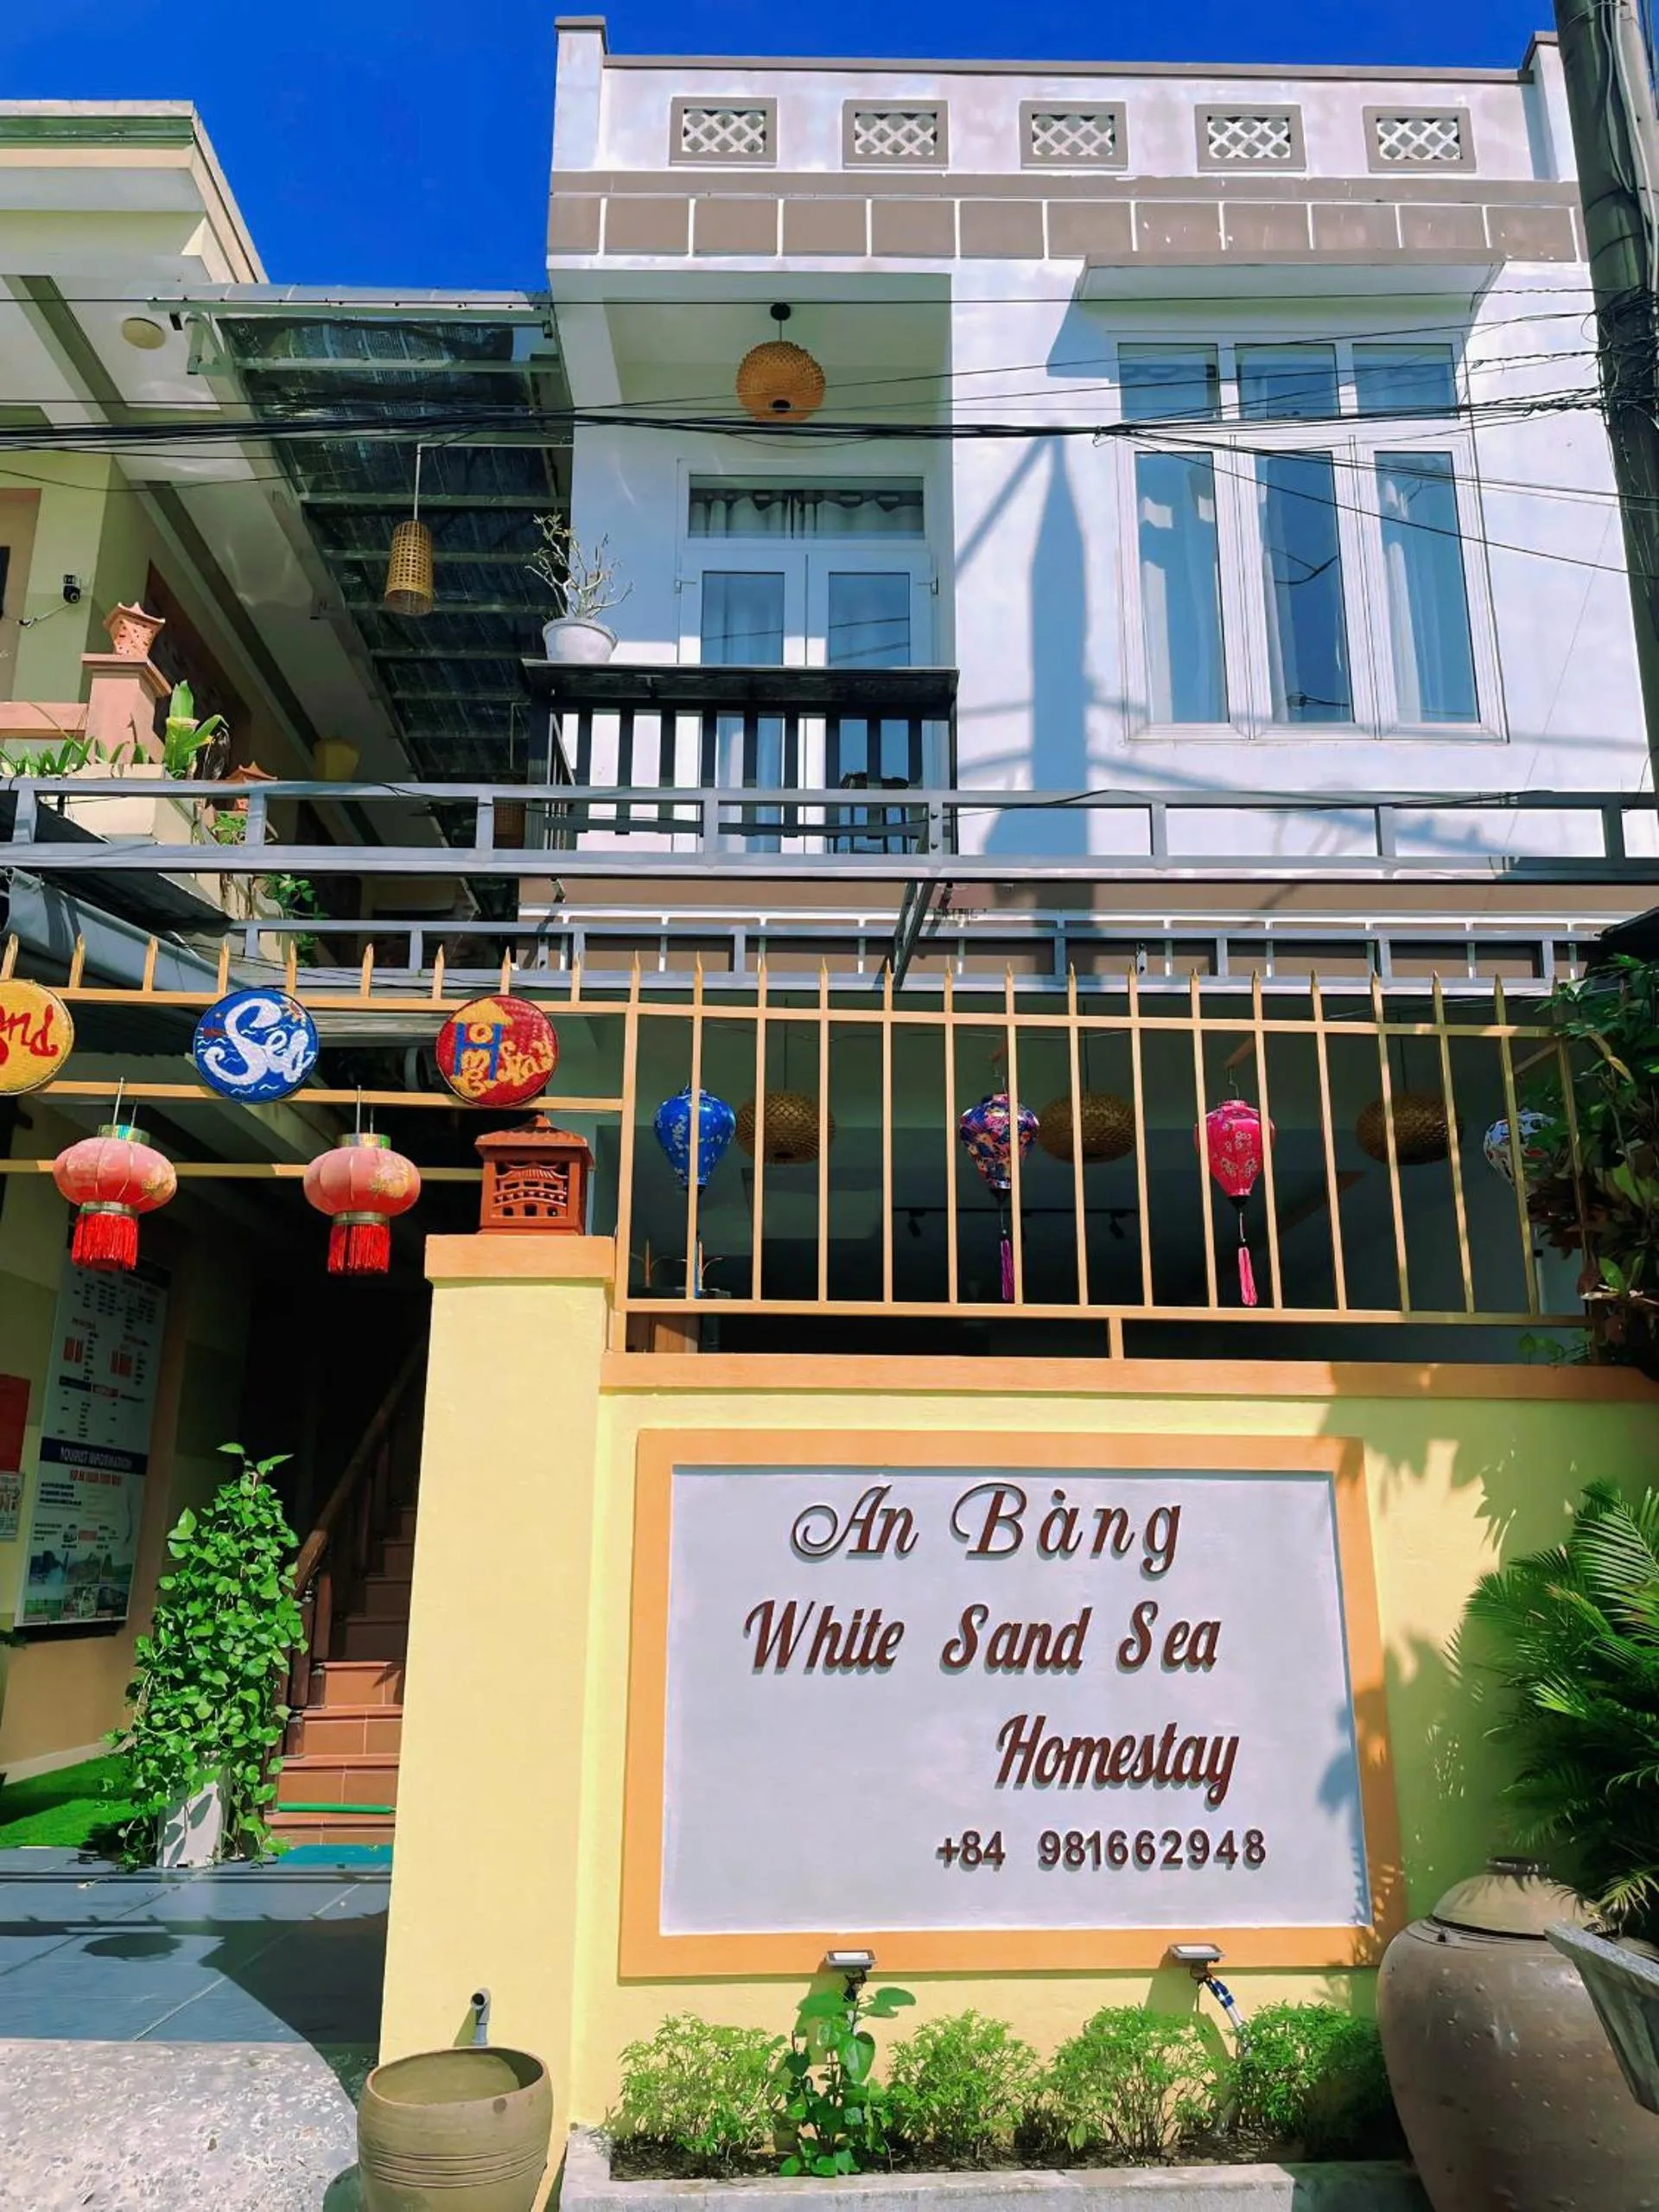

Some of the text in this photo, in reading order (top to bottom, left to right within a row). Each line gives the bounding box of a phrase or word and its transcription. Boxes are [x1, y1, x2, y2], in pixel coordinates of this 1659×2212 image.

[204, 998, 316, 1085] Sea
[791, 1484, 917, 1558] An
[745, 1599, 1221, 1671] White Sand Sea
[996, 1714, 1240, 1806] Homestay
[938, 1829, 1266, 1867] +84 981662948
